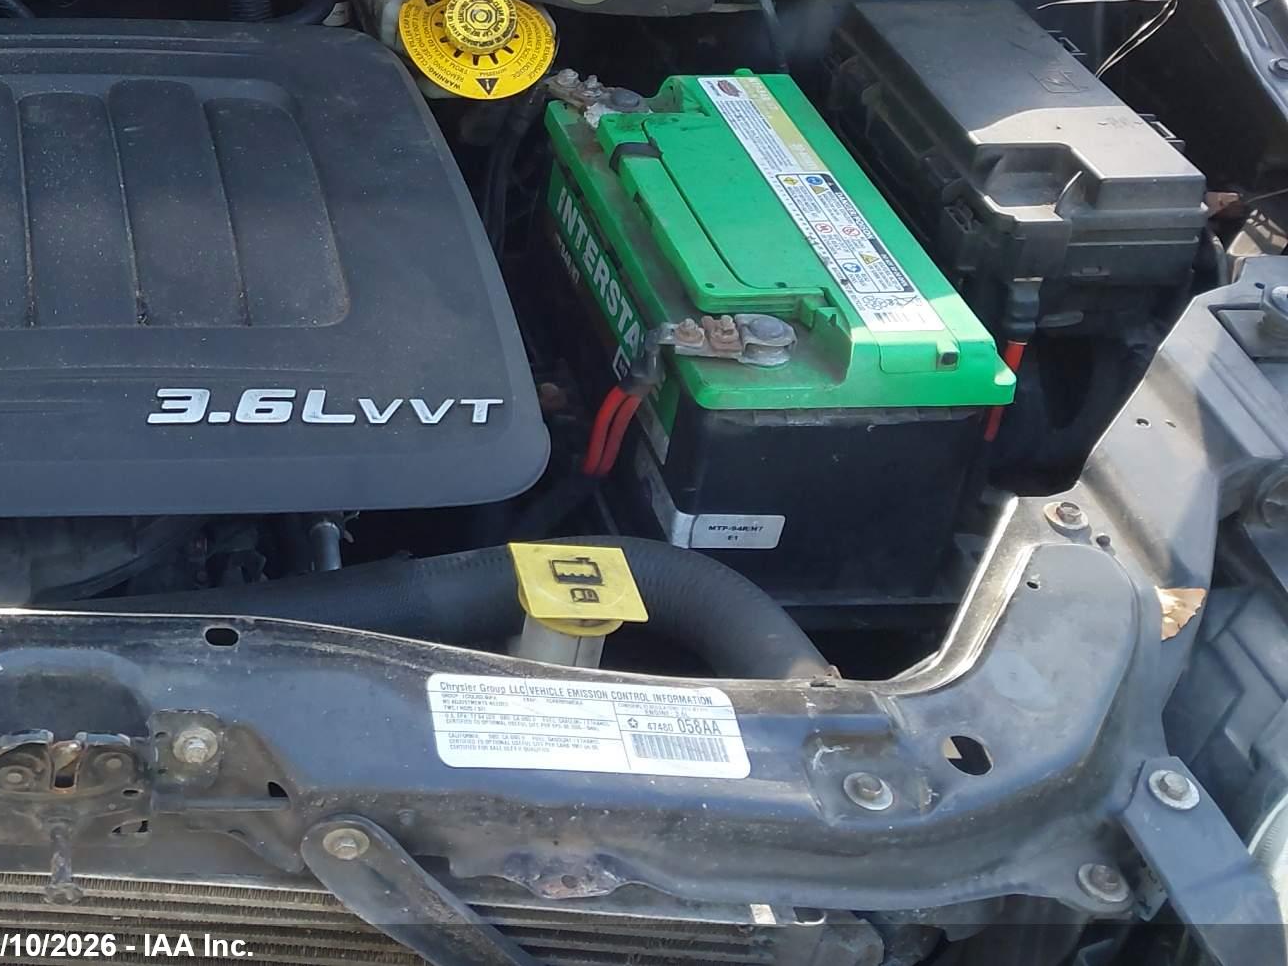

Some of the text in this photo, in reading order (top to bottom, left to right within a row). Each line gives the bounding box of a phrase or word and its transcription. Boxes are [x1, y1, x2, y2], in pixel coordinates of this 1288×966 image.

[556, 186, 646, 359] INTERSTA
[440, 681, 526, 695] Chrysler Group LLC
[529, 686, 713, 706] VEHICLE EMISSION CONTROL INFORMATION
[677, 718, 722, 735] 058AA
